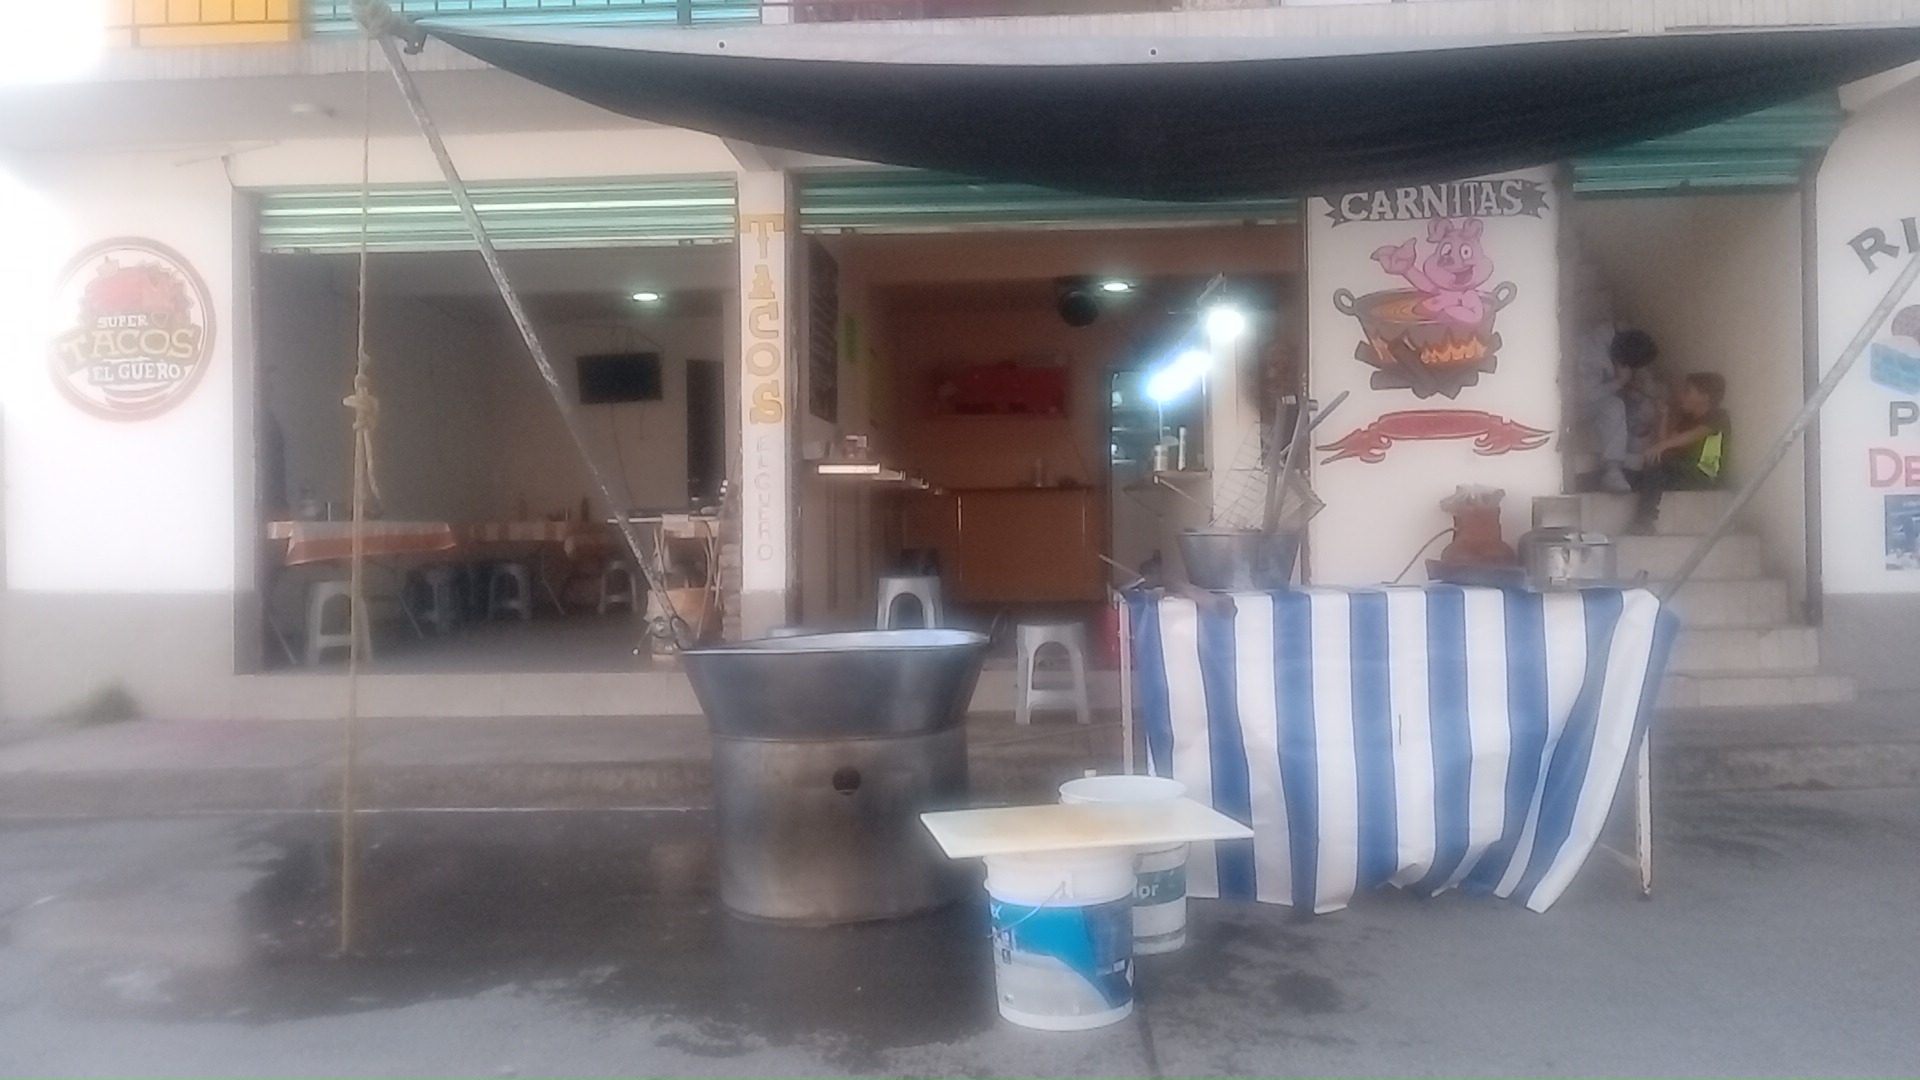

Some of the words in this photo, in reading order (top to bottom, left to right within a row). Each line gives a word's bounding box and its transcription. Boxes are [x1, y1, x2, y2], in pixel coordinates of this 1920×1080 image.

[1340, 180, 1523, 221] CARNITAS
[97, 315, 148, 328] SUPER
[741, 214, 784, 424] TACOS
[59, 328, 195, 366] TACOS
[92, 366, 114, 382] EL
